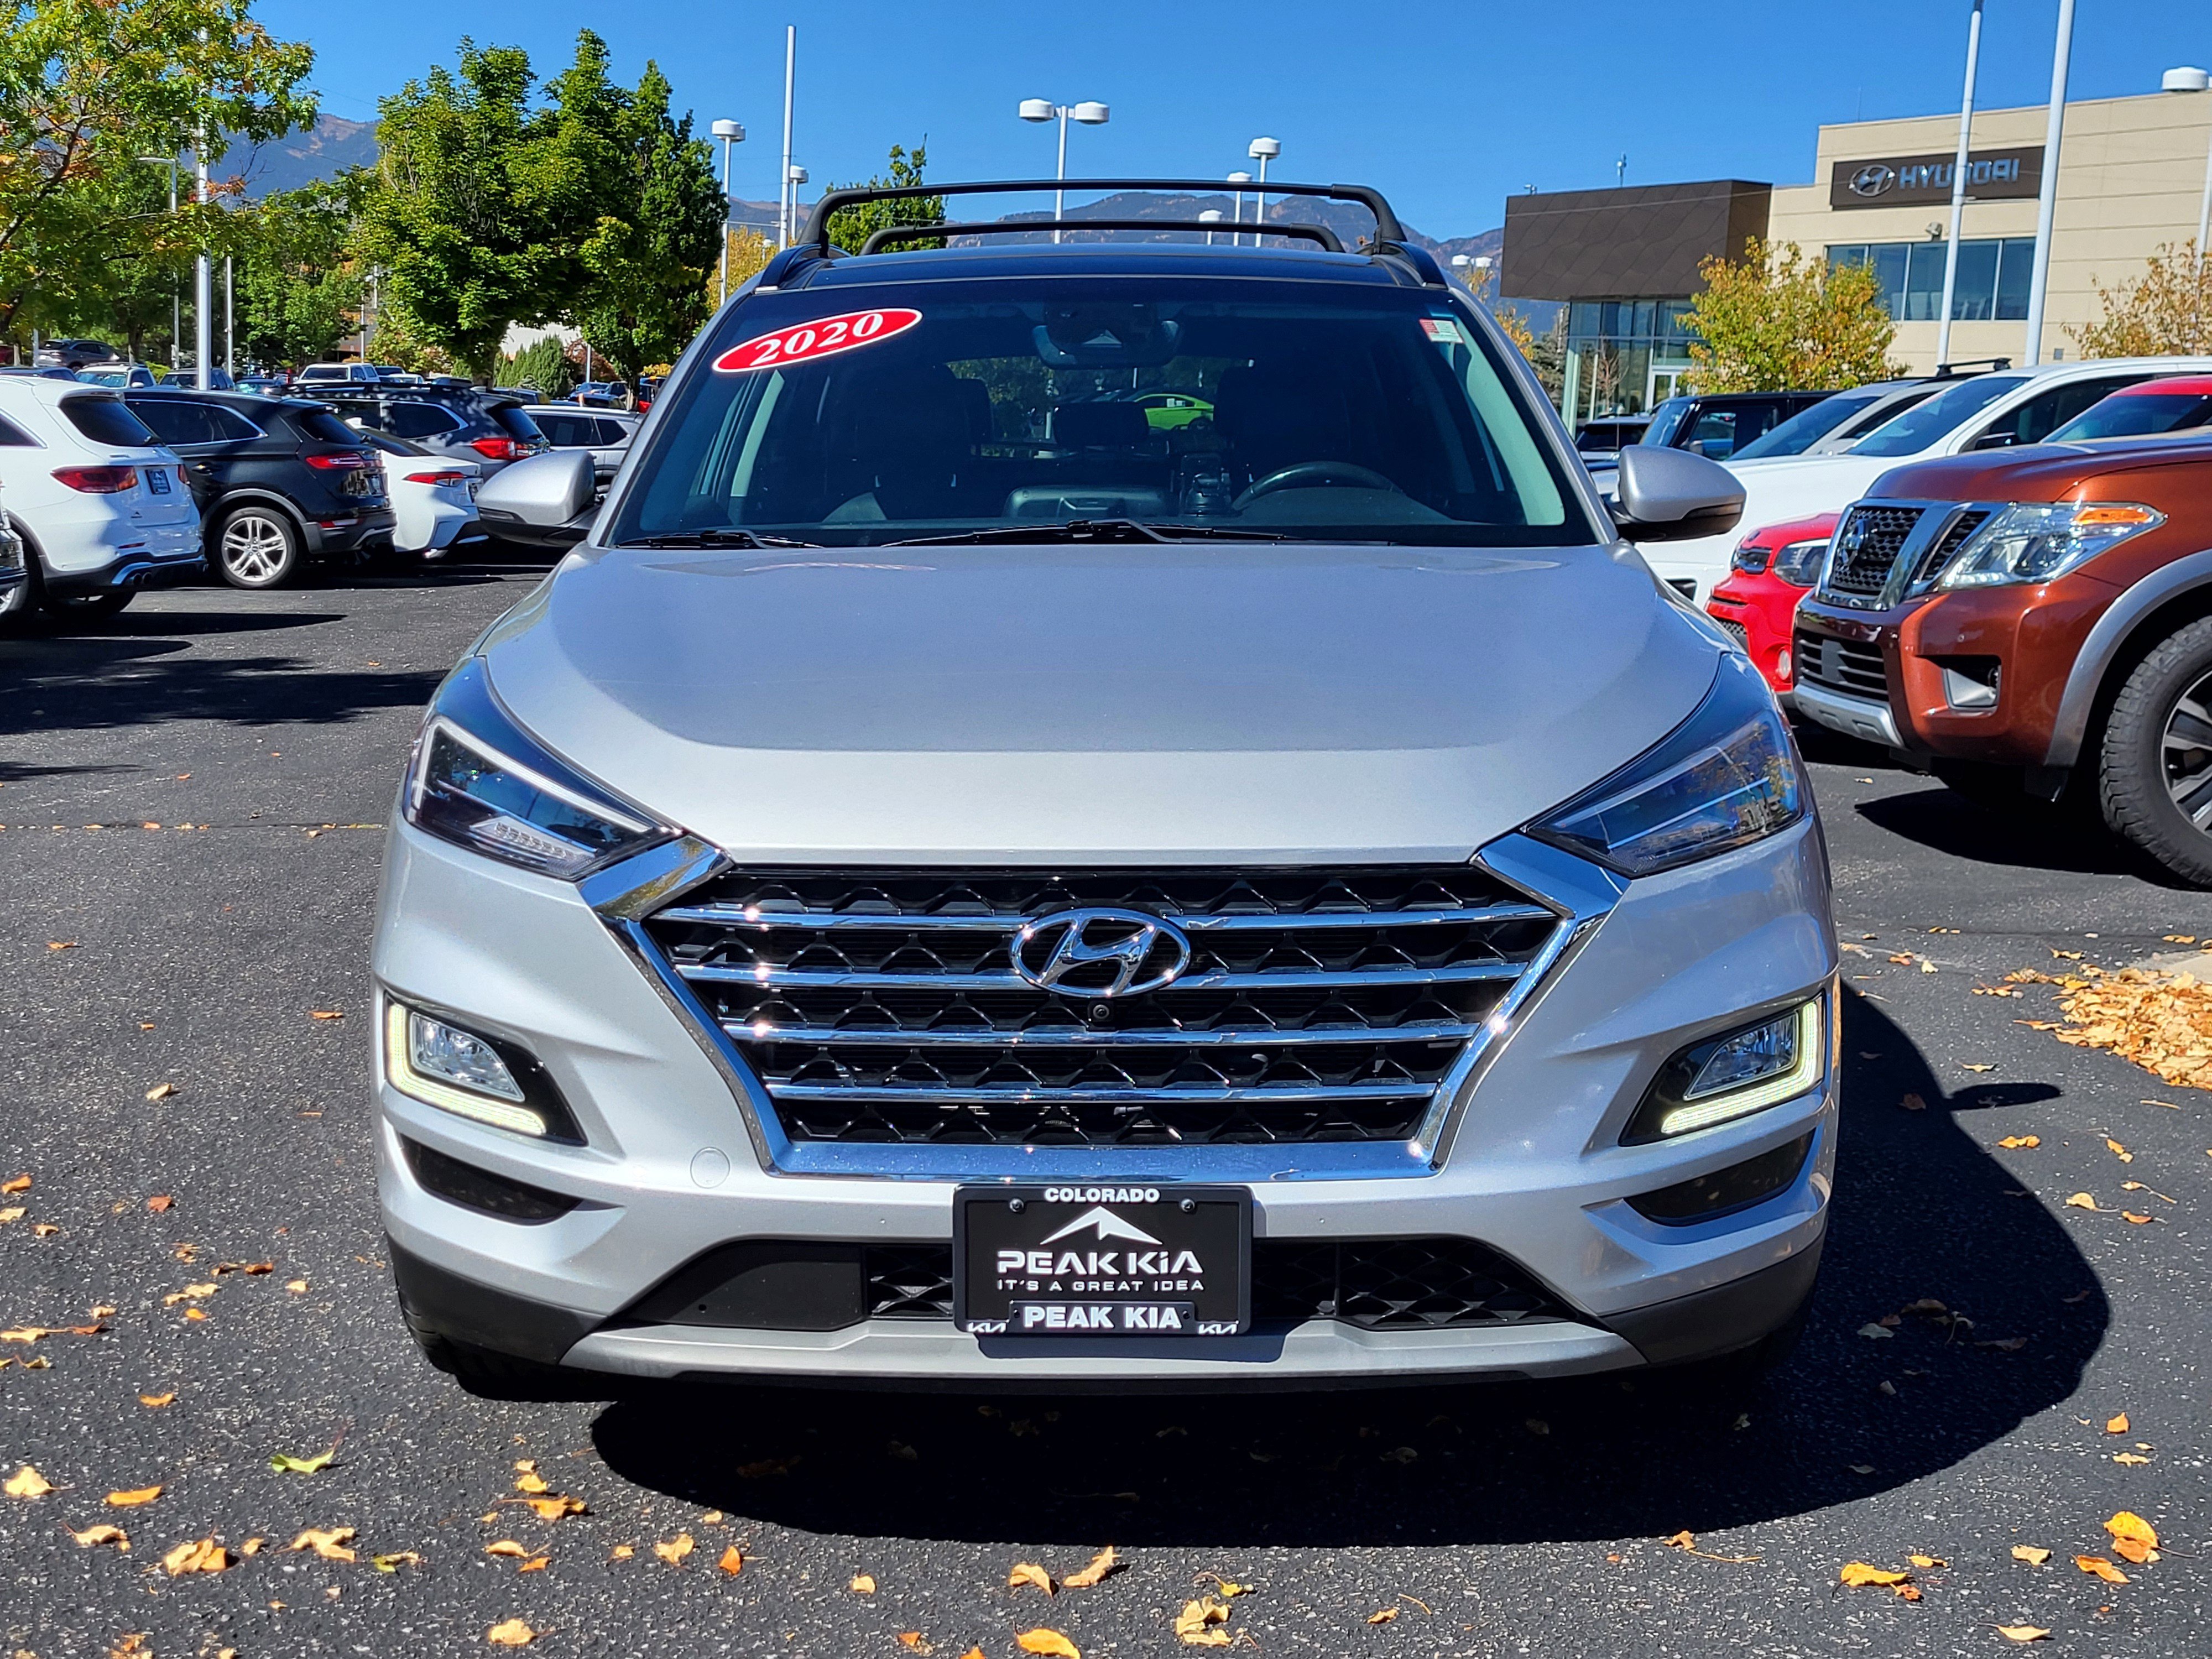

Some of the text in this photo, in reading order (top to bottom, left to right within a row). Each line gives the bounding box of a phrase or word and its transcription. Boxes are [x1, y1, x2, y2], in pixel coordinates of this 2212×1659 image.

[749, 313, 884, 366] 2020
[1044, 1188, 1160, 1203] COLORADO
[997, 1250, 1120, 1275] PEAK
[997, 1279, 1204, 1292] IT'S A GREAT IDEA
[1024, 1306, 1182, 1329] PEAK KIA
